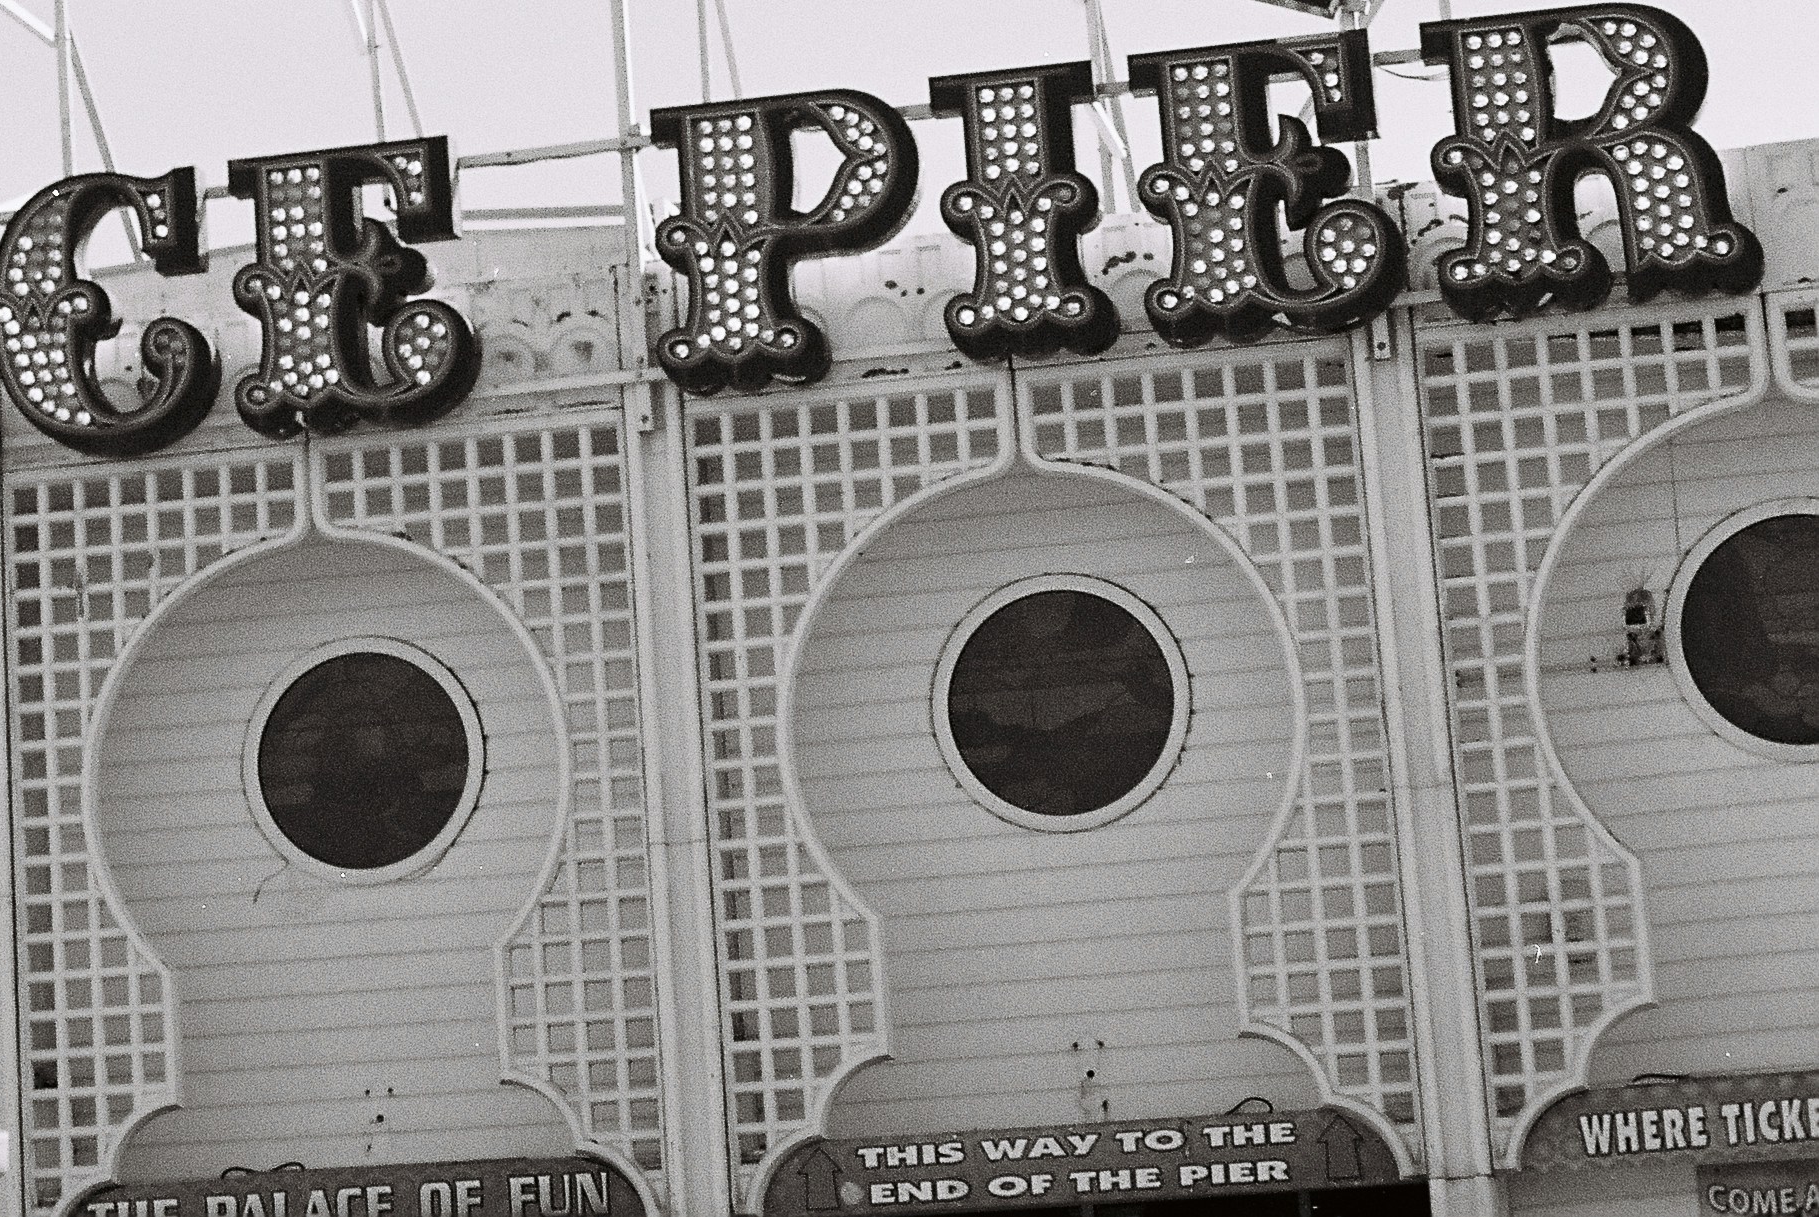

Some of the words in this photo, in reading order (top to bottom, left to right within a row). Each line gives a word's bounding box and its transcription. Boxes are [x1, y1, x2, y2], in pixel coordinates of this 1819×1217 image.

[650, 1, 1765, 392] PIER
[857, 1142, 964, 1168] THIS
[981, 1134, 1099, 1160] WAY
[1116, 1130, 1183, 1152] TO
[1203, 1123, 1295, 1147] THE
[1580, 1107, 1707, 1154] WHERE
[1722, 1097, 1819, 1144] TICKE
[419, 1180, 481, 1217] OF
[508, 1172, 608, 1217] FUN
[871, 1180, 969, 1204] END
[988, 1174, 1053, 1197] OF
[1070, 1168, 1161, 1192] THE
[1180, 1161, 1289, 1186] PIER
[1708, 1185, 1797, 1214] COME
